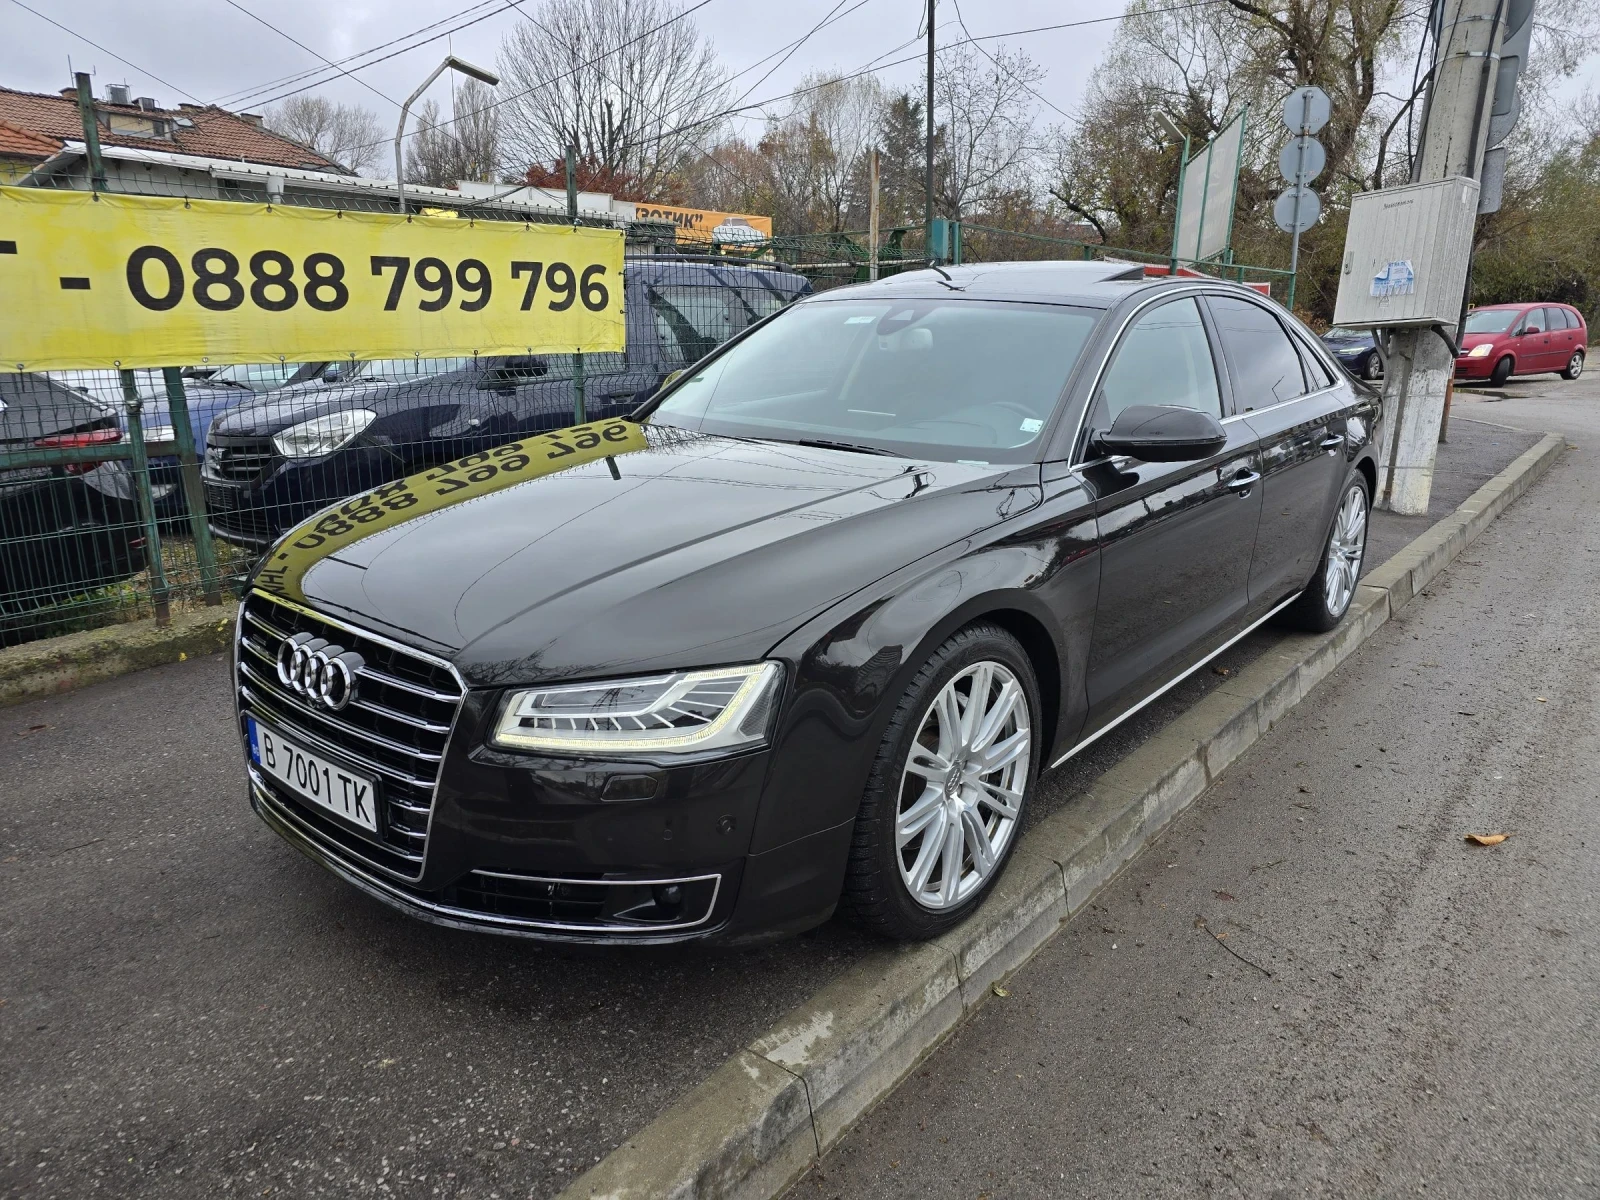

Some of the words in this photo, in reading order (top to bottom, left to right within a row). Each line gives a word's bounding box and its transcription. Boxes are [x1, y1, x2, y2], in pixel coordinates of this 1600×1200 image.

[126, 245, 349, 312] 0888
[370, 255, 492, 312] 799
[511, 261, 609, 312] 796
[263, 731, 276, 769] B
[282, 744, 333, 805] 7001
[337, 772, 371, 824] TK
